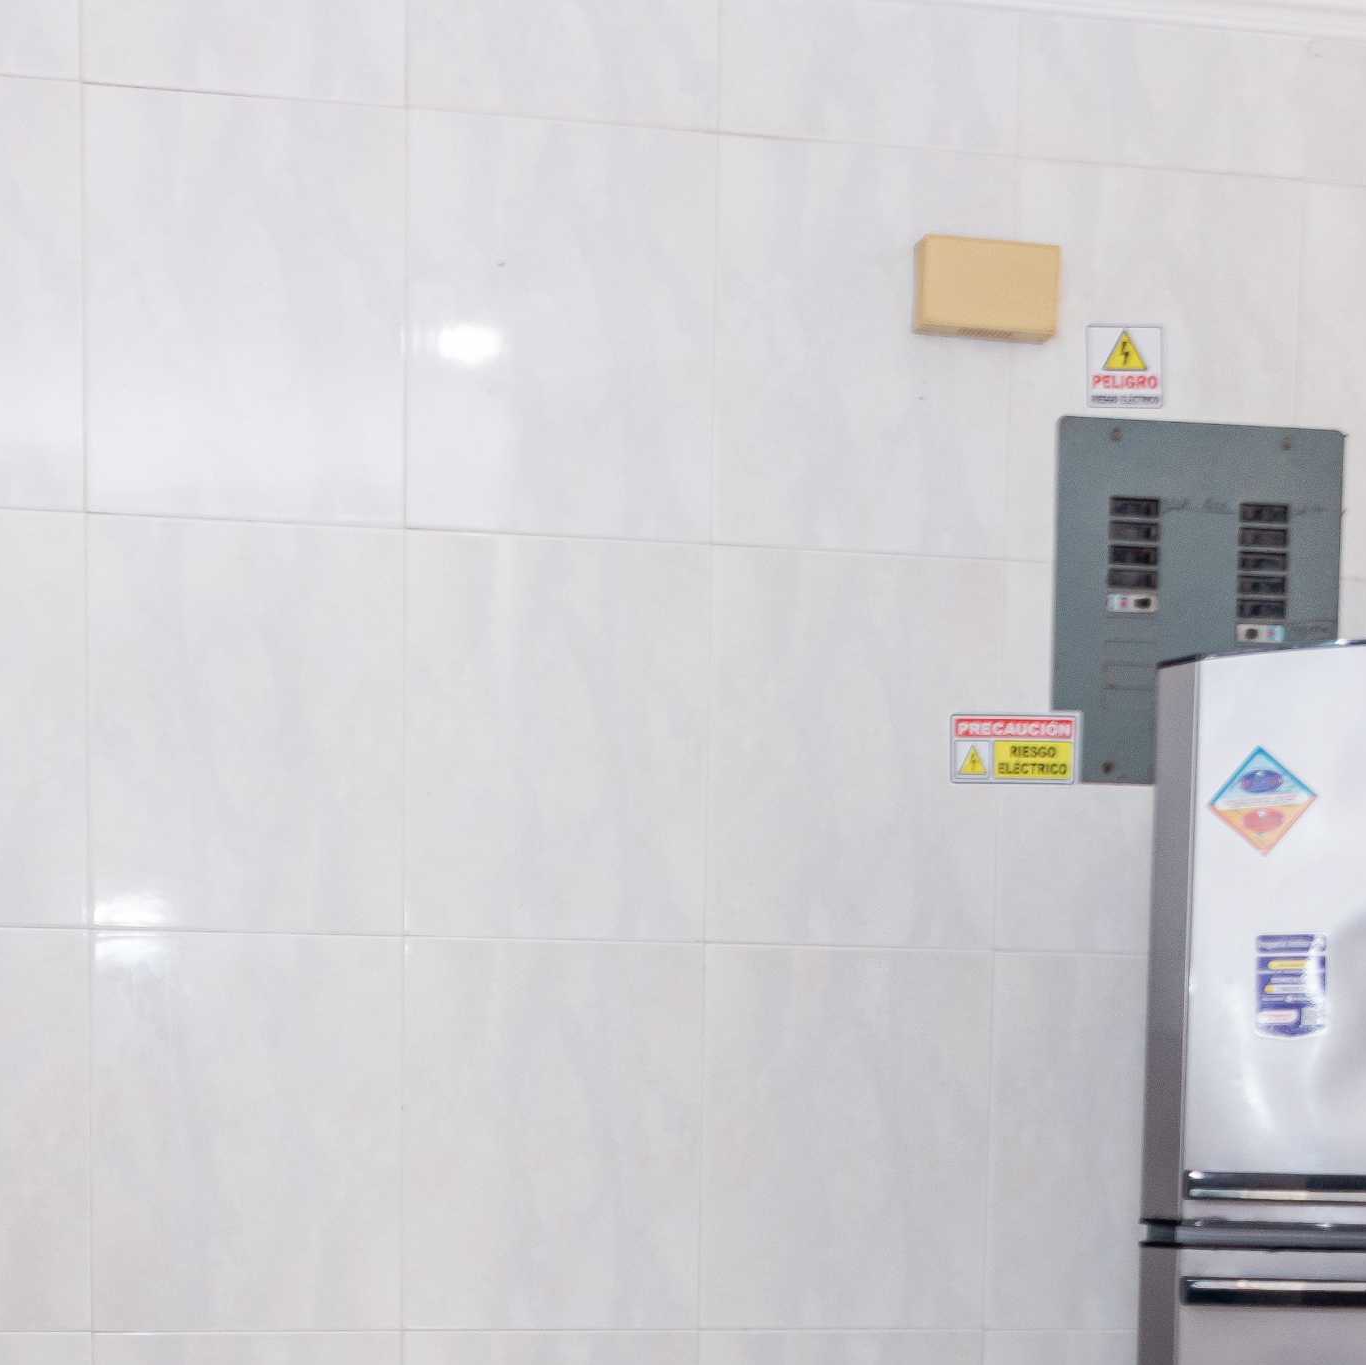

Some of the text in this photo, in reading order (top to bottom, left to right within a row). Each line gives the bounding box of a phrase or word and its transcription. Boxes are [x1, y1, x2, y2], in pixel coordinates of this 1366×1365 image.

[1091, 374, 1158, 389] PELIGRO
[957, 720, 1072, 736] PRECAUCIÓN
[1010, 745, 1057, 758] RIESGO
